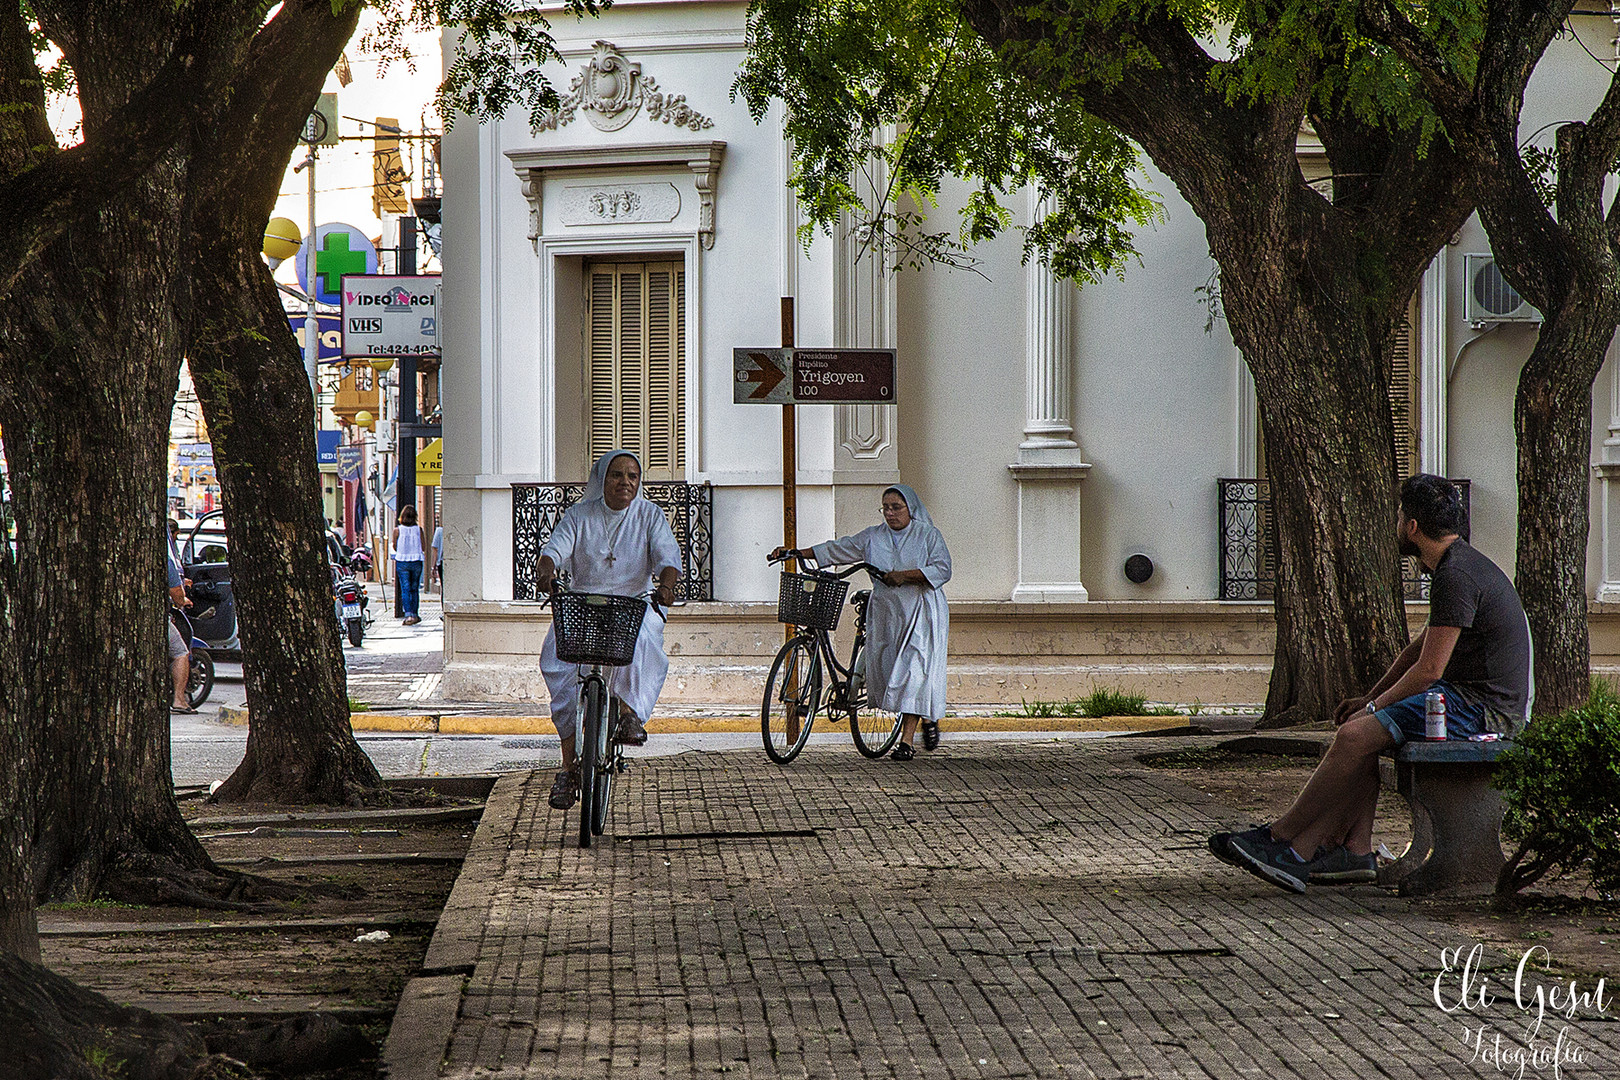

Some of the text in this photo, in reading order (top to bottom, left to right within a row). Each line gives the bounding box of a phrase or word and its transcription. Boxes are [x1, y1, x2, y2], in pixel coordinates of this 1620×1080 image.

[351, 319, 380, 331] VHS
[798, 352, 838, 360] Presidente
[799, 370, 865, 385] Yrigoyen
[799, 386, 888, 396] 100 0
